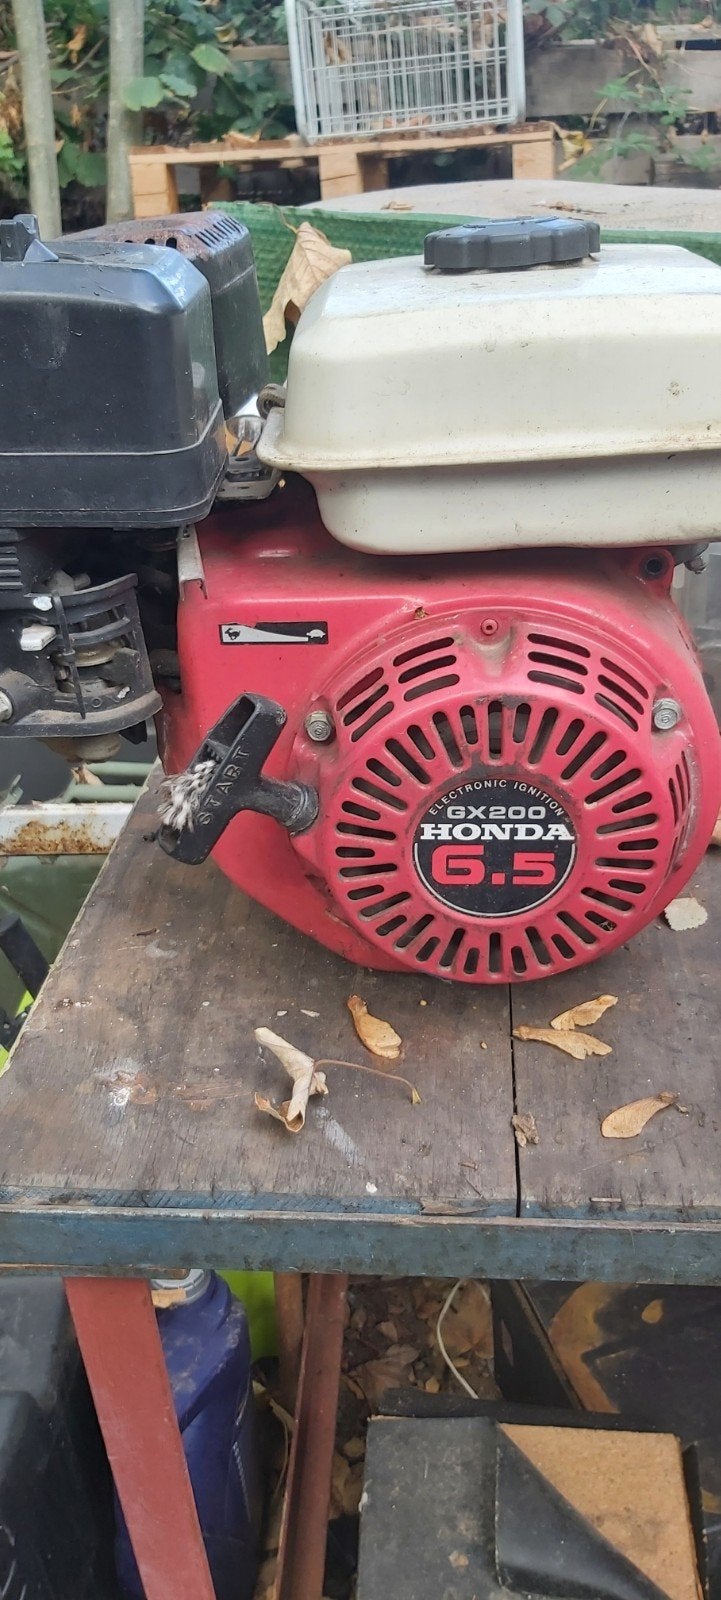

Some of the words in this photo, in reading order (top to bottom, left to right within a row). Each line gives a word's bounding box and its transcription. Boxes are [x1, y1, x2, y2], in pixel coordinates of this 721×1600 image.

[429, 780, 507, 815] ELECTRONIC
[513, 782, 565, 816] IGNITION
[447, 806, 546, 819] GX200
[420, 823, 575, 840] HONDA
[431, 844, 556, 885] 6.5
